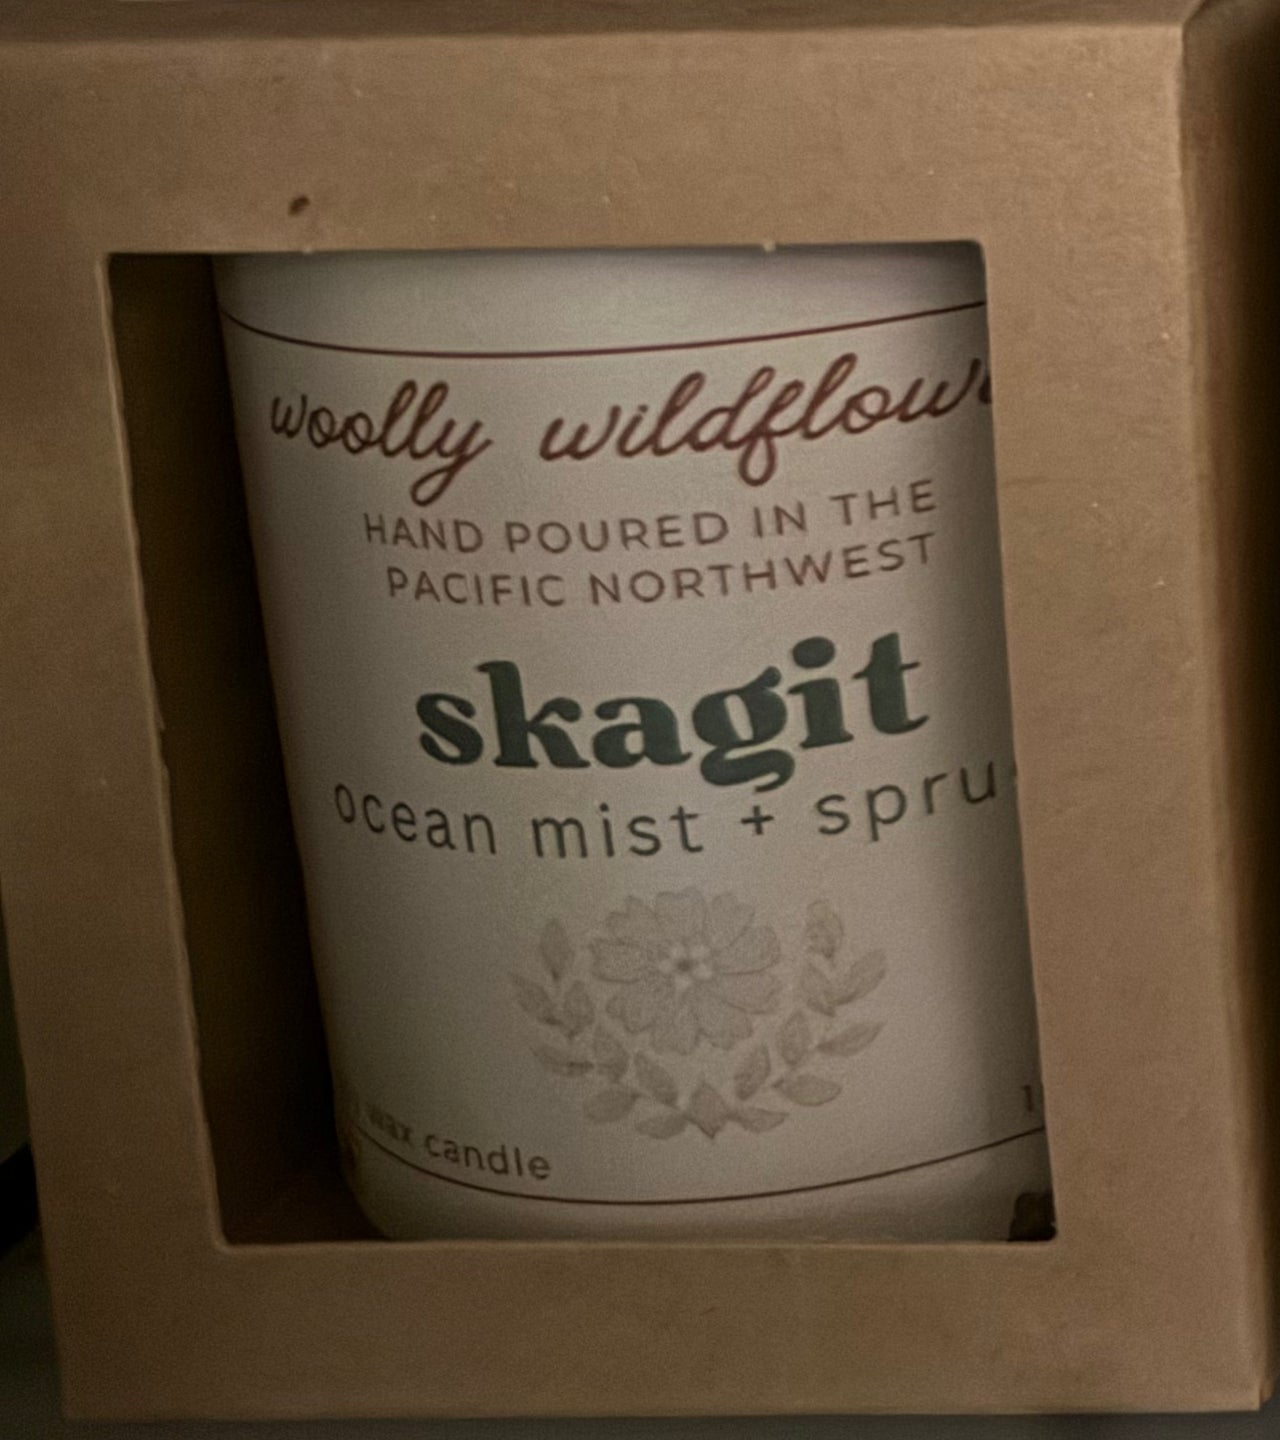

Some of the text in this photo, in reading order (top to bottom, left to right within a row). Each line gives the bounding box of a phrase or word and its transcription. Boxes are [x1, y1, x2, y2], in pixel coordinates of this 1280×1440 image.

[269, 353, 994, 507] woolly wildflow
[362, 478, 939, 555] HAND POURED IN THE
[386, 532, 938, 609] PACIFIC NORTHWEST
[413, 632, 930, 794] skagit
[333, 766, 1016, 860] ocean mist + spru
[424, 1133, 552, 1182] candle
